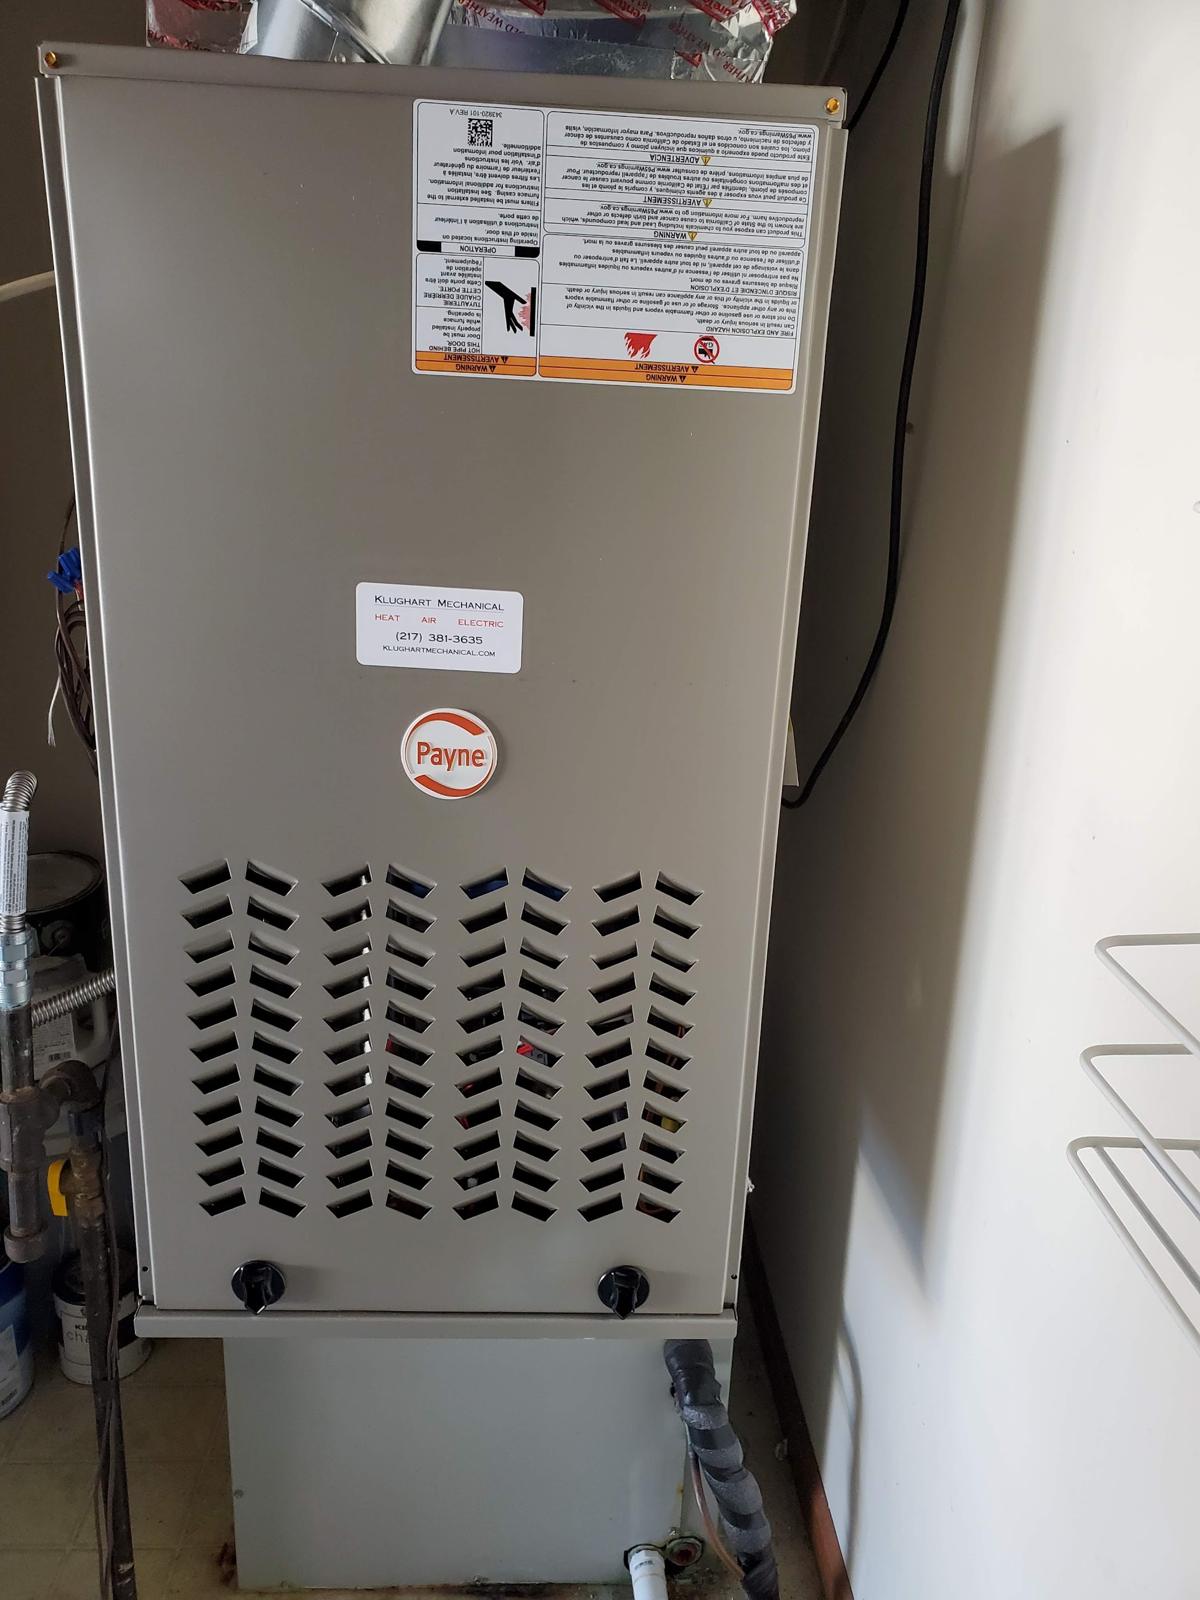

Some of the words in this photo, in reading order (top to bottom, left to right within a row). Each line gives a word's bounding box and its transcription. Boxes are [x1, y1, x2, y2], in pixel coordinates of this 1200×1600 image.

[649, 153, 699, 163] ADVERTENCIA
[643, 196, 701, 205] AVERTISSEMENT
[653, 230, 686, 238] WARNING
[459, 245, 496, 253] OPERATION
[443, 353, 498, 362] AVERTISSEMENT
[634, 363, 689, 371] AVERTISSEMENT
[374, 614, 400, 622] HEAT
[458, 618, 504, 628] ELECTRIC
[396, 632, 422, 643] (217)
[428, 634, 483, 645] 381-3635
[417, 742, 485, 772] Payne
